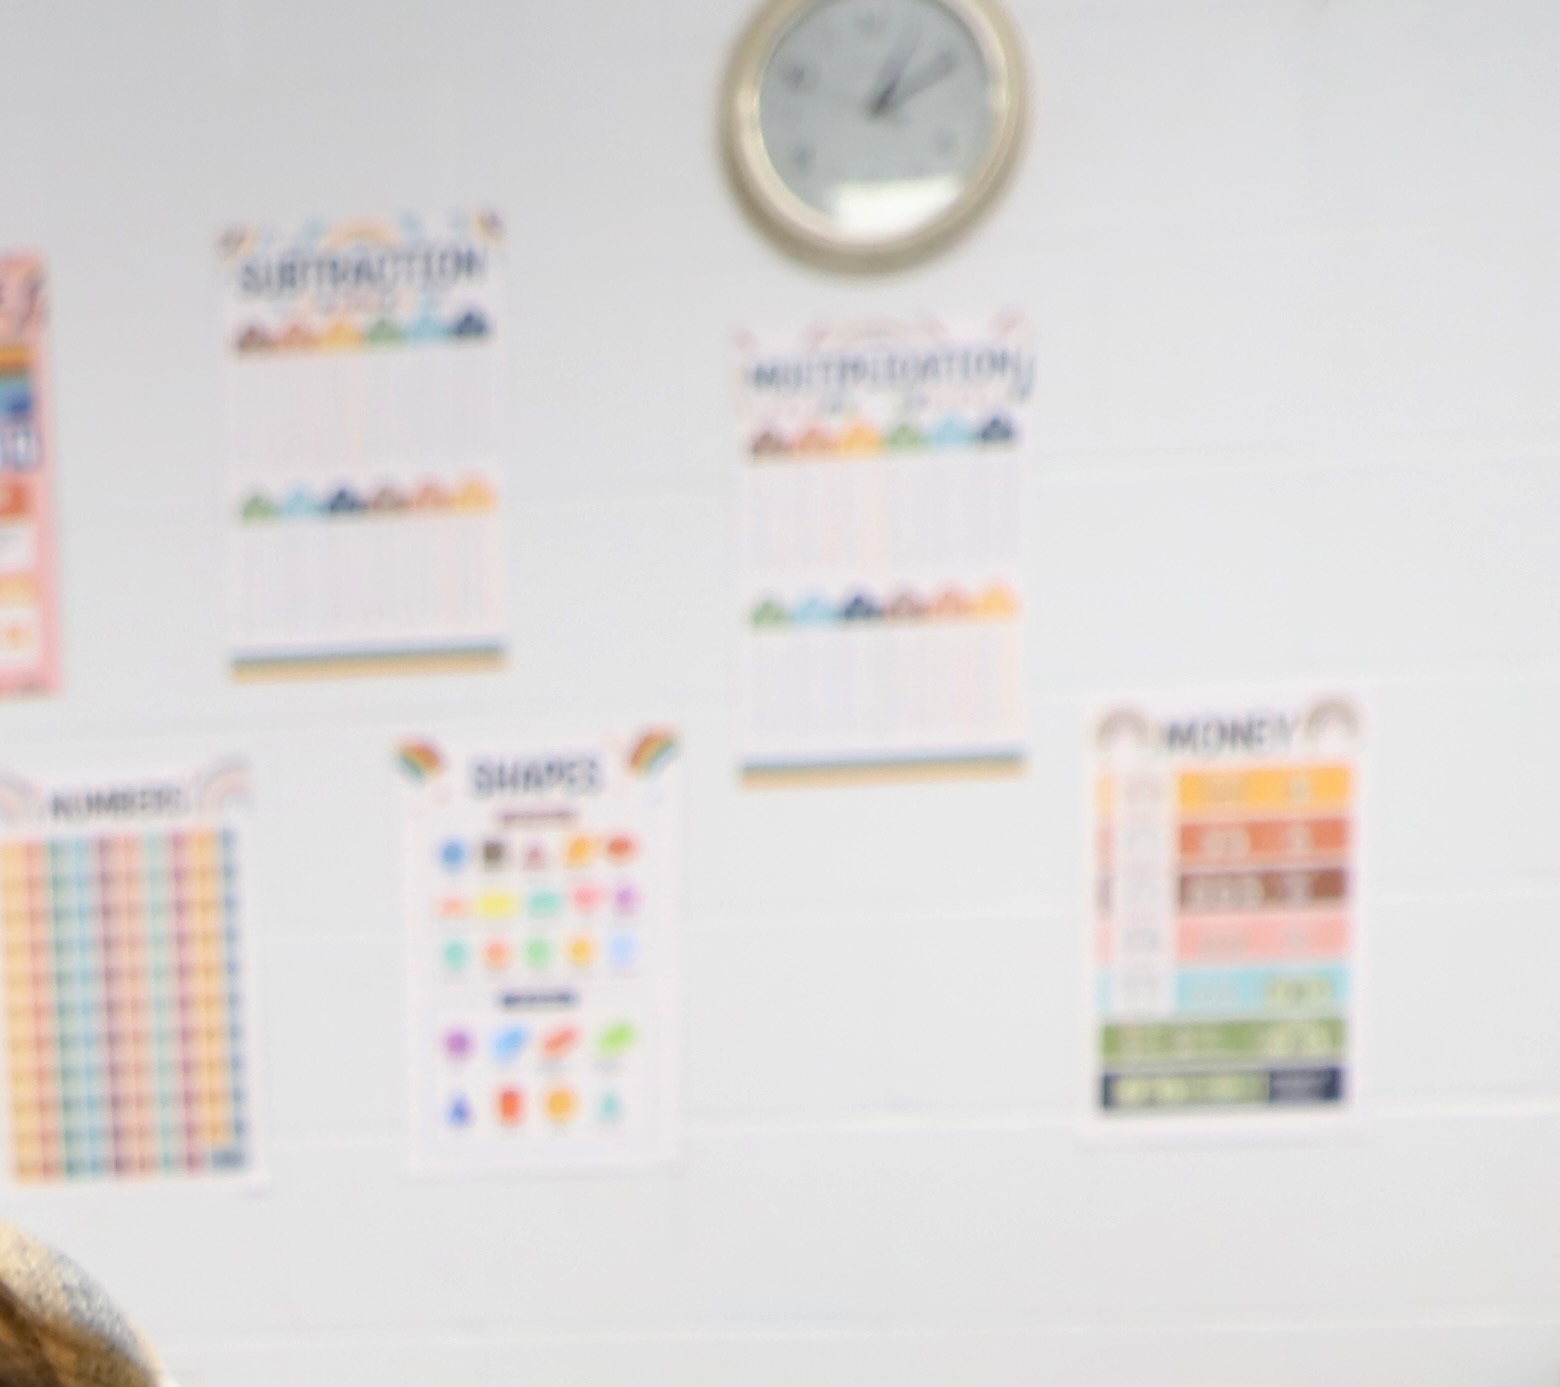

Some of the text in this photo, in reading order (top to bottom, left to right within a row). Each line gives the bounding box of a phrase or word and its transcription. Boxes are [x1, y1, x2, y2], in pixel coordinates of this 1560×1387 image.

[239, 247, 487, 297] SUBTRACTION
[749, 347, 1014, 393] MULTIPLICATION
[1166, 712, 1299, 756] MONEY
[473, 756, 602, 797] SHAPES
[50, 785, 189, 821] NUMBERS
